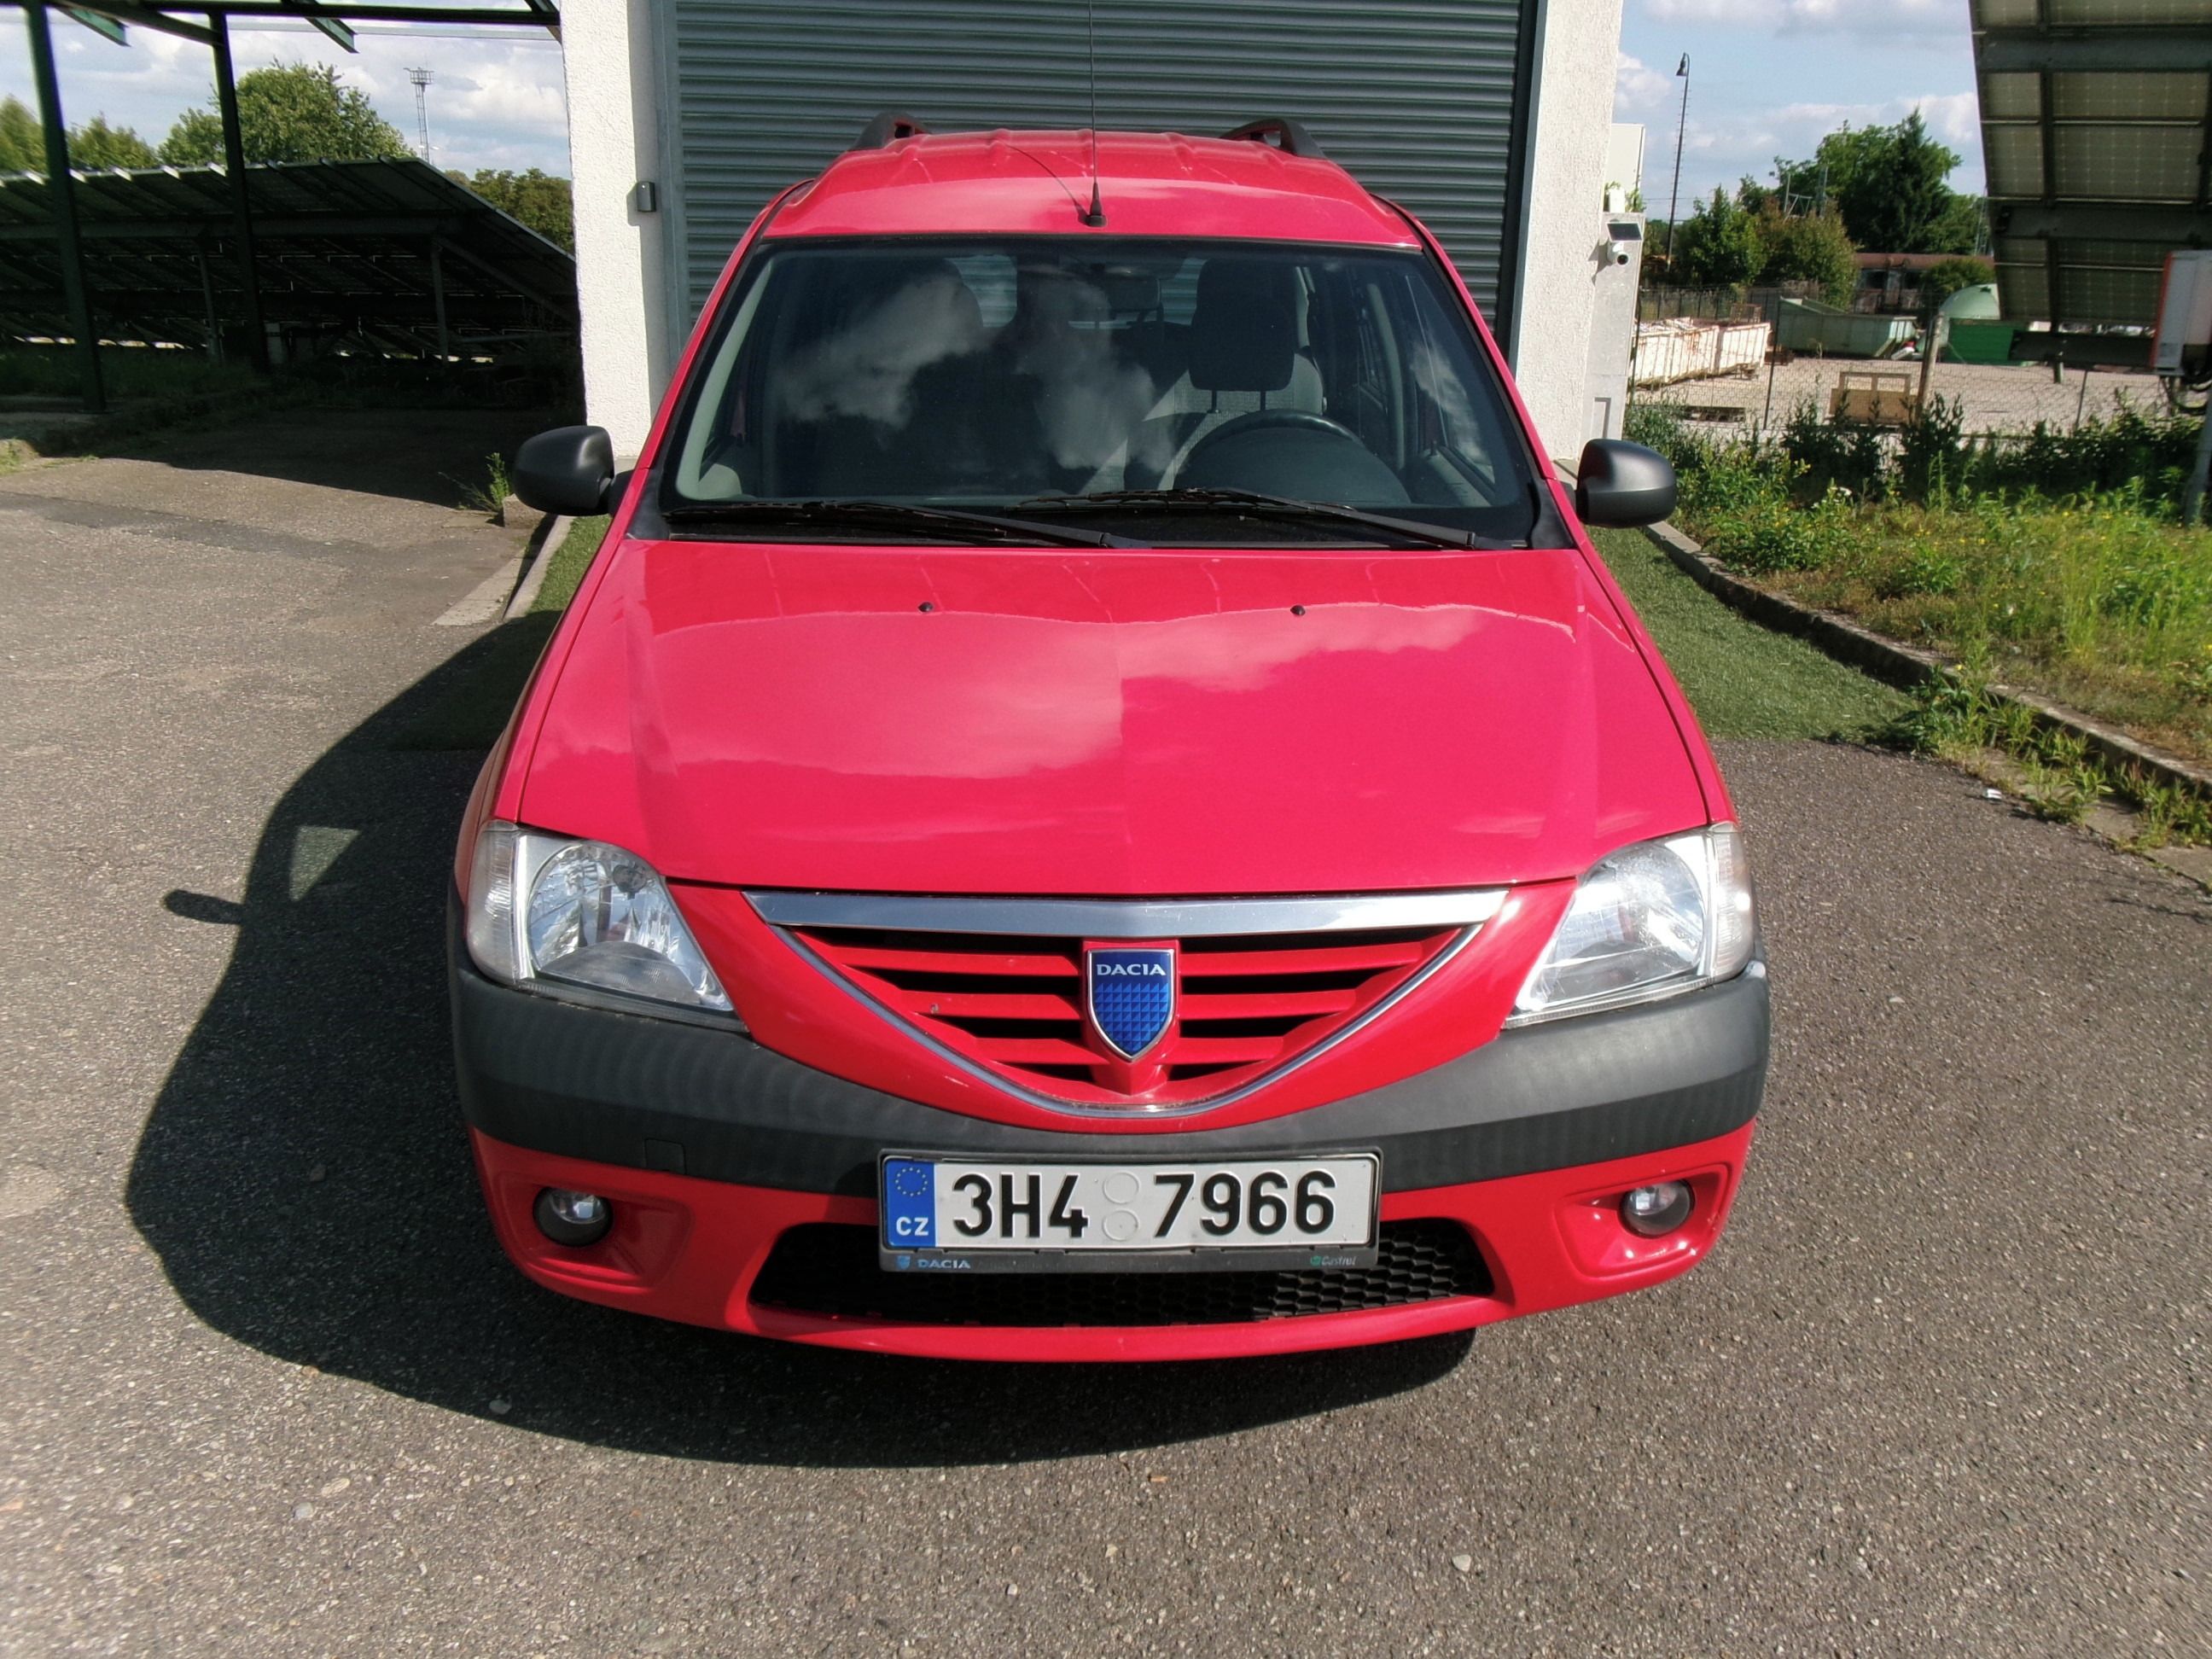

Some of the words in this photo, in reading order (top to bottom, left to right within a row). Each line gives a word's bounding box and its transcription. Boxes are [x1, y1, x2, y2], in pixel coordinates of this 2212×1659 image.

[1097, 963, 1167, 975] DACIA
[952, 1173, 1089, 1237] 3H4
[1154, 1170, 1336, 1237] 7966
[896, 1217, 928, 1237] CZ
[917, 1258, 971, 1269] DACIA
